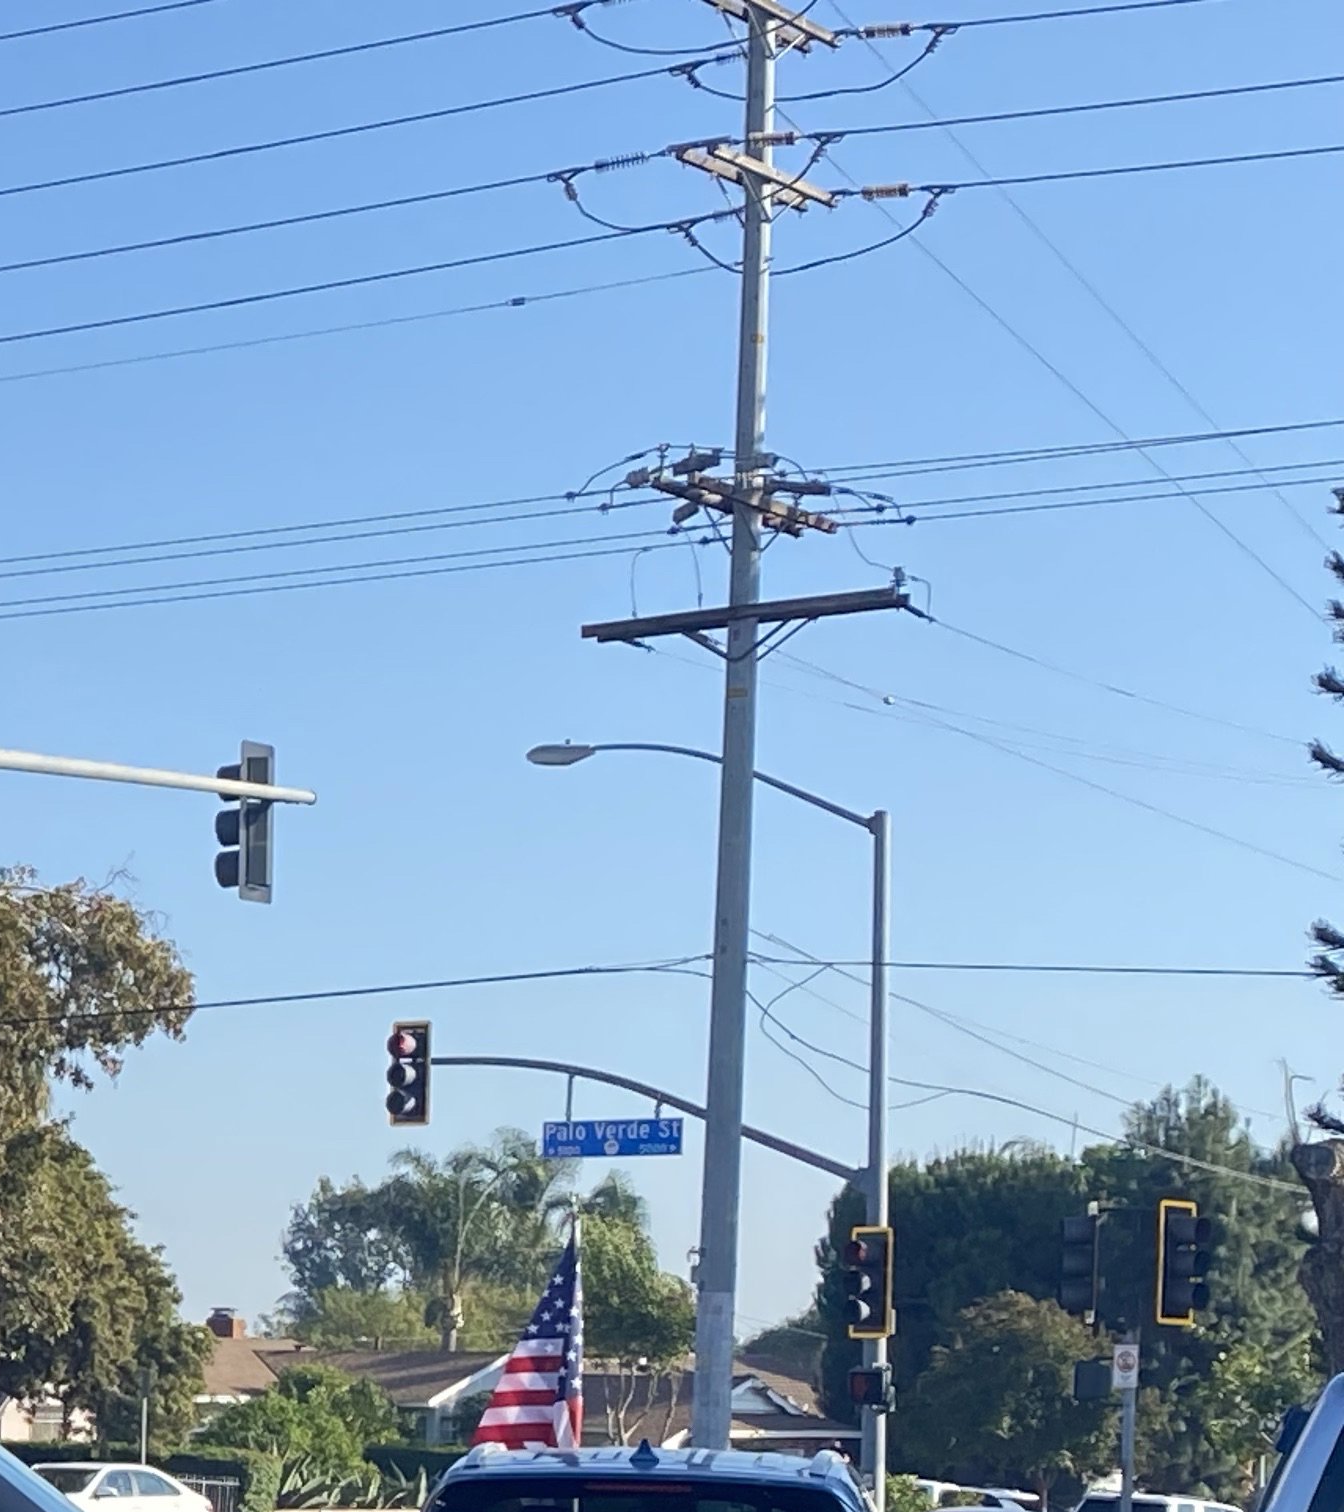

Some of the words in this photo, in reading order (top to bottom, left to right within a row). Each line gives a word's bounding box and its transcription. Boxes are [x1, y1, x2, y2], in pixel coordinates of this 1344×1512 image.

[545, 1123, 587, 1142] Palo
[594, 1120, 651, 1141] Verde
[657, 1119, 682, 1140] St
